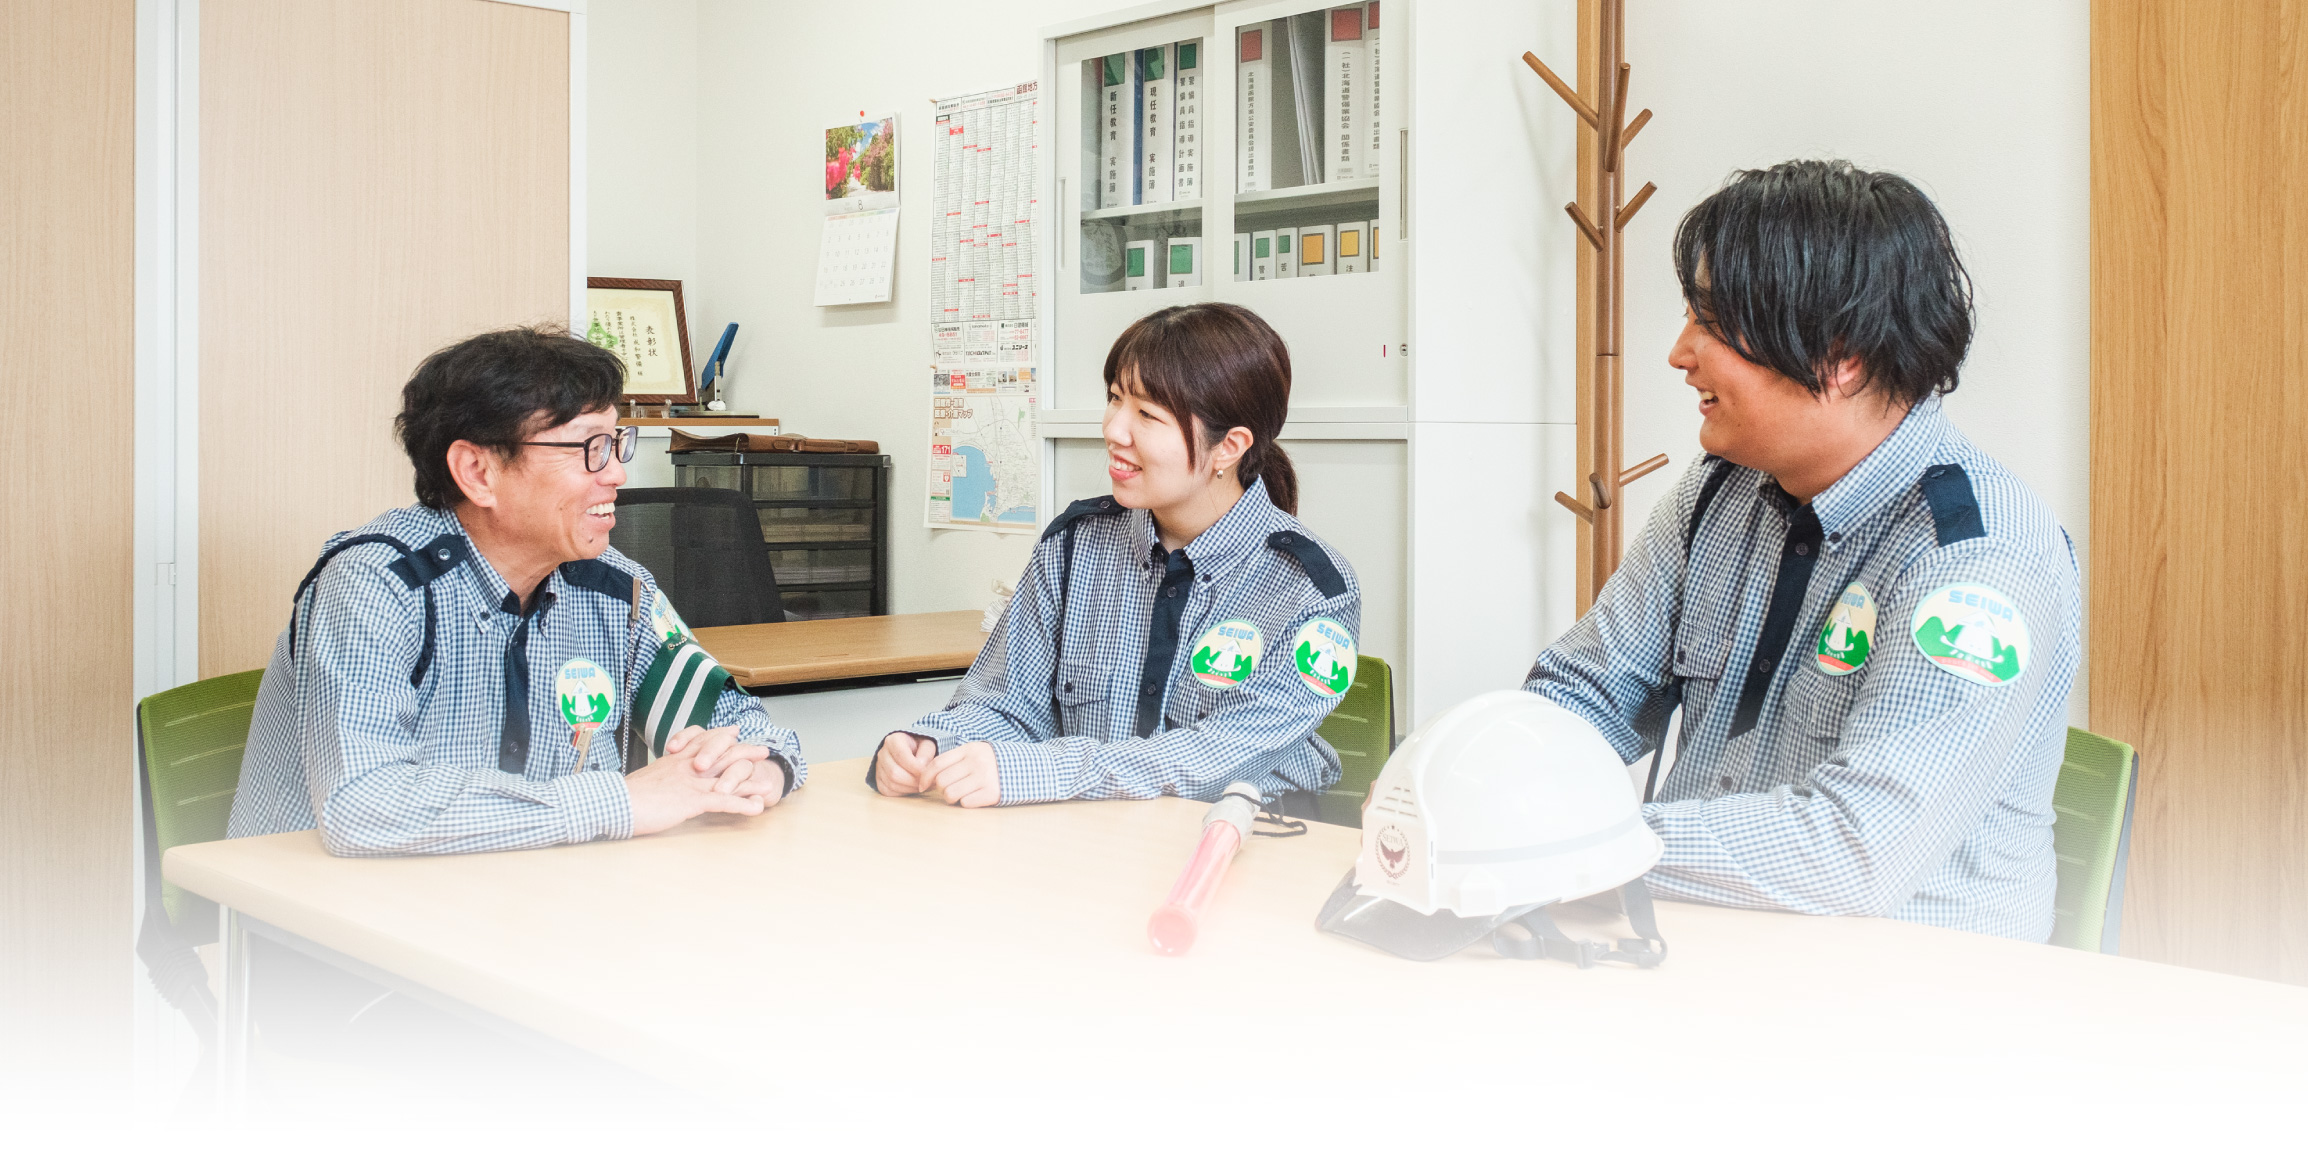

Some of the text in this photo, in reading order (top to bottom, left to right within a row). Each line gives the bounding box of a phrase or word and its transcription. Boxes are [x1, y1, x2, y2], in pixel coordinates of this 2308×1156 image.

[1186, 76, 1194, 186] 警備員指導実施簿
[1341, 134, 1350, 162] 関係書類
[858, 200, 864, 211] 8
[1346, 264, 1353, 273] 注
[646, 325, 658, 356] 表彰状
[1840, 592, 1865, 608] SEIWA
[1949, 590, 2012, 622] SEIWA
[1218, 626, 1255, 640] SEIWA
[1317, 623, 1350, 650] SEIWA
[564, 667, 596, 680] SEIWA
[1382, 834, 1404, 847] SEIWA
